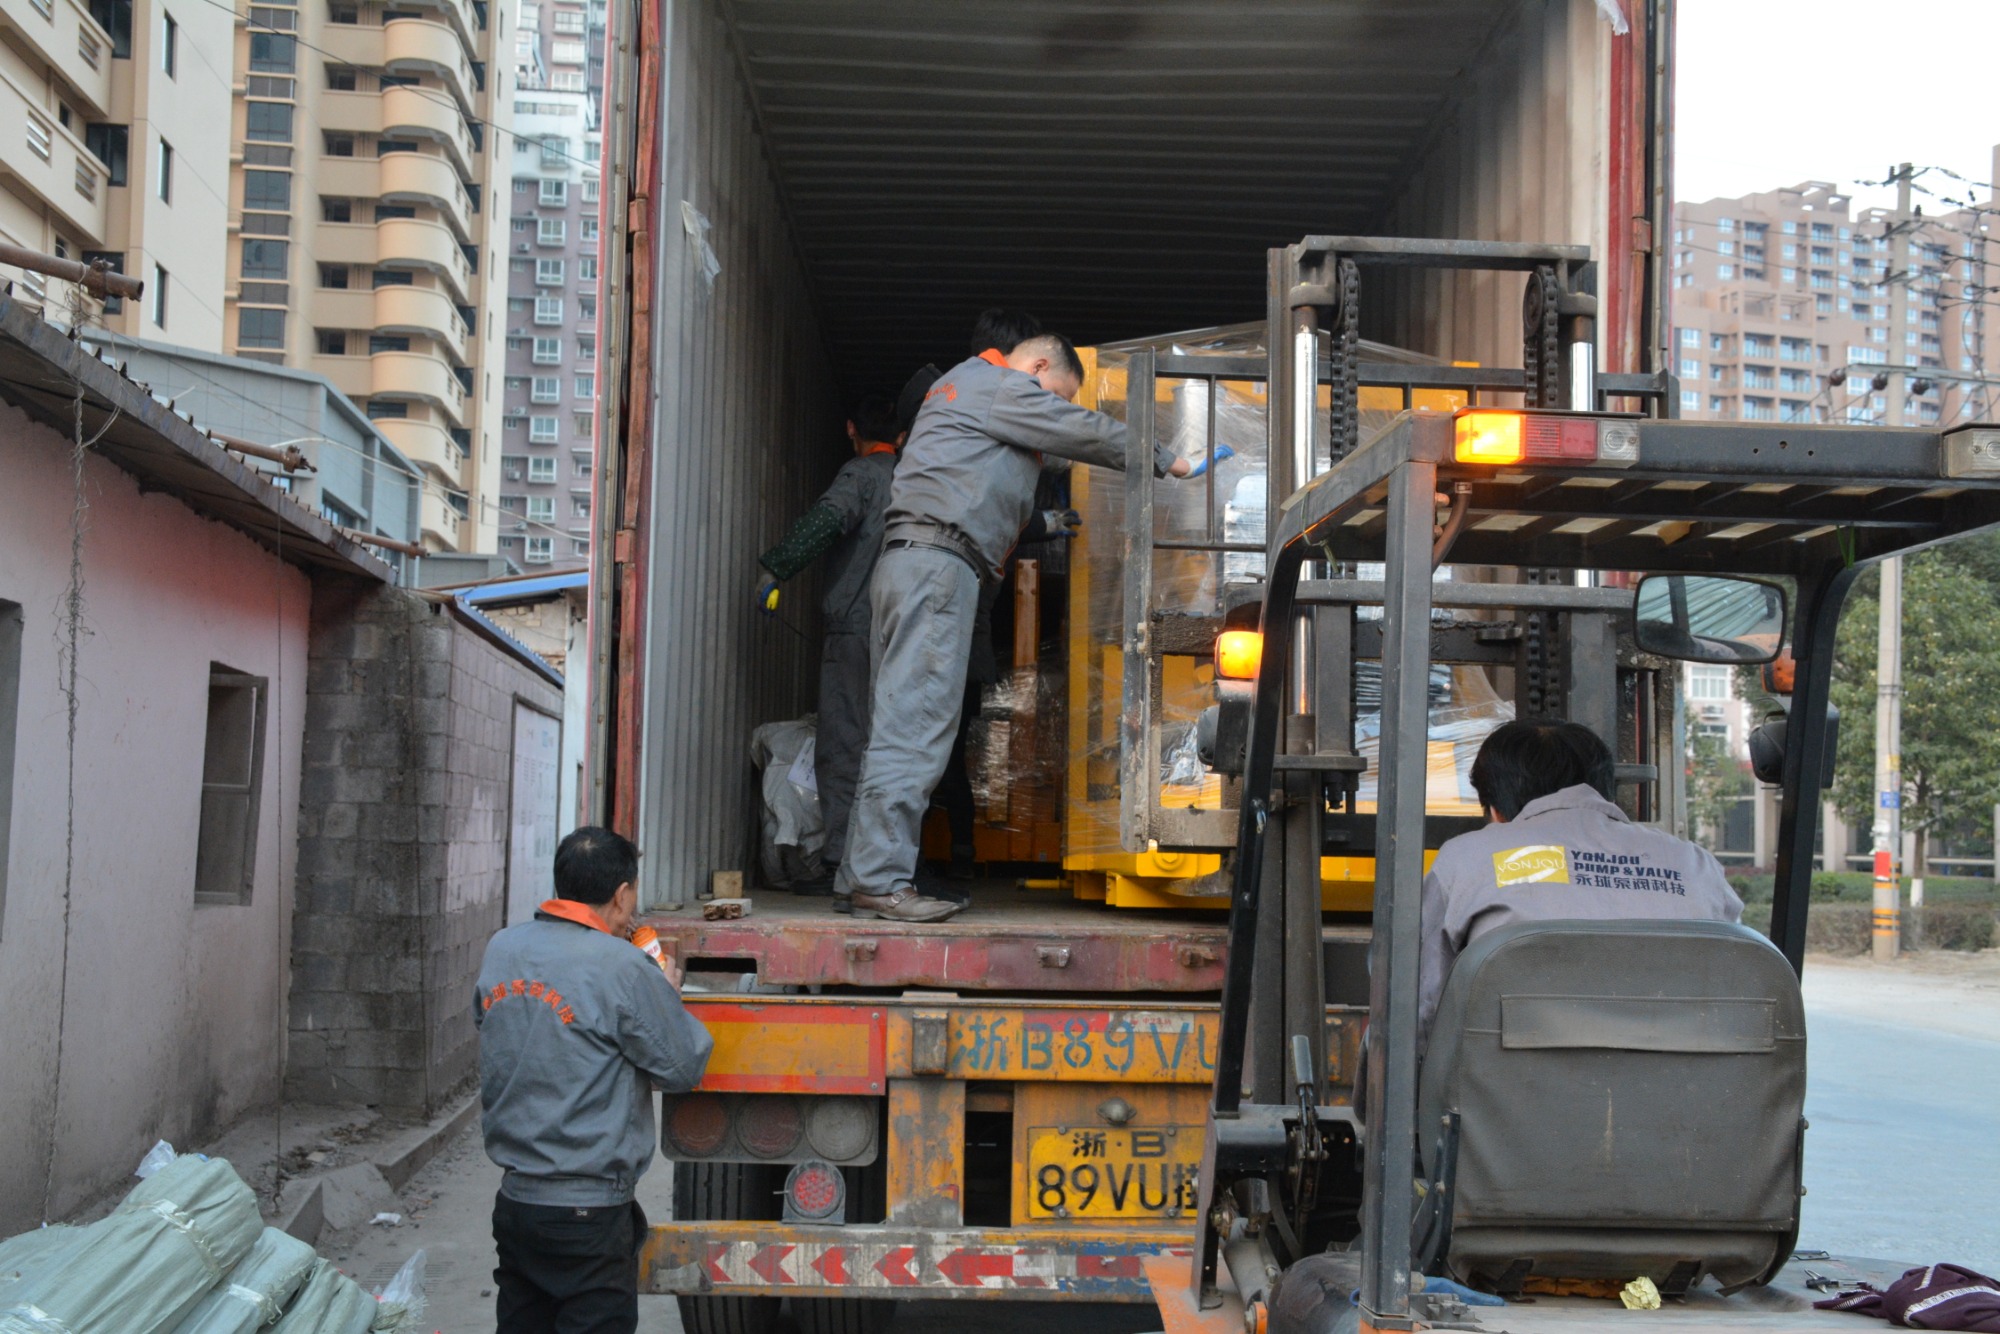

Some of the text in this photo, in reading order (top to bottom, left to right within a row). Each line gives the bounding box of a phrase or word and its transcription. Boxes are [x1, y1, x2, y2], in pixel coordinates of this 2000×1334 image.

[1497, 858, 1566, 873] YONJOU
[1574, 862, 1682, 882] PUMP & VALVE
